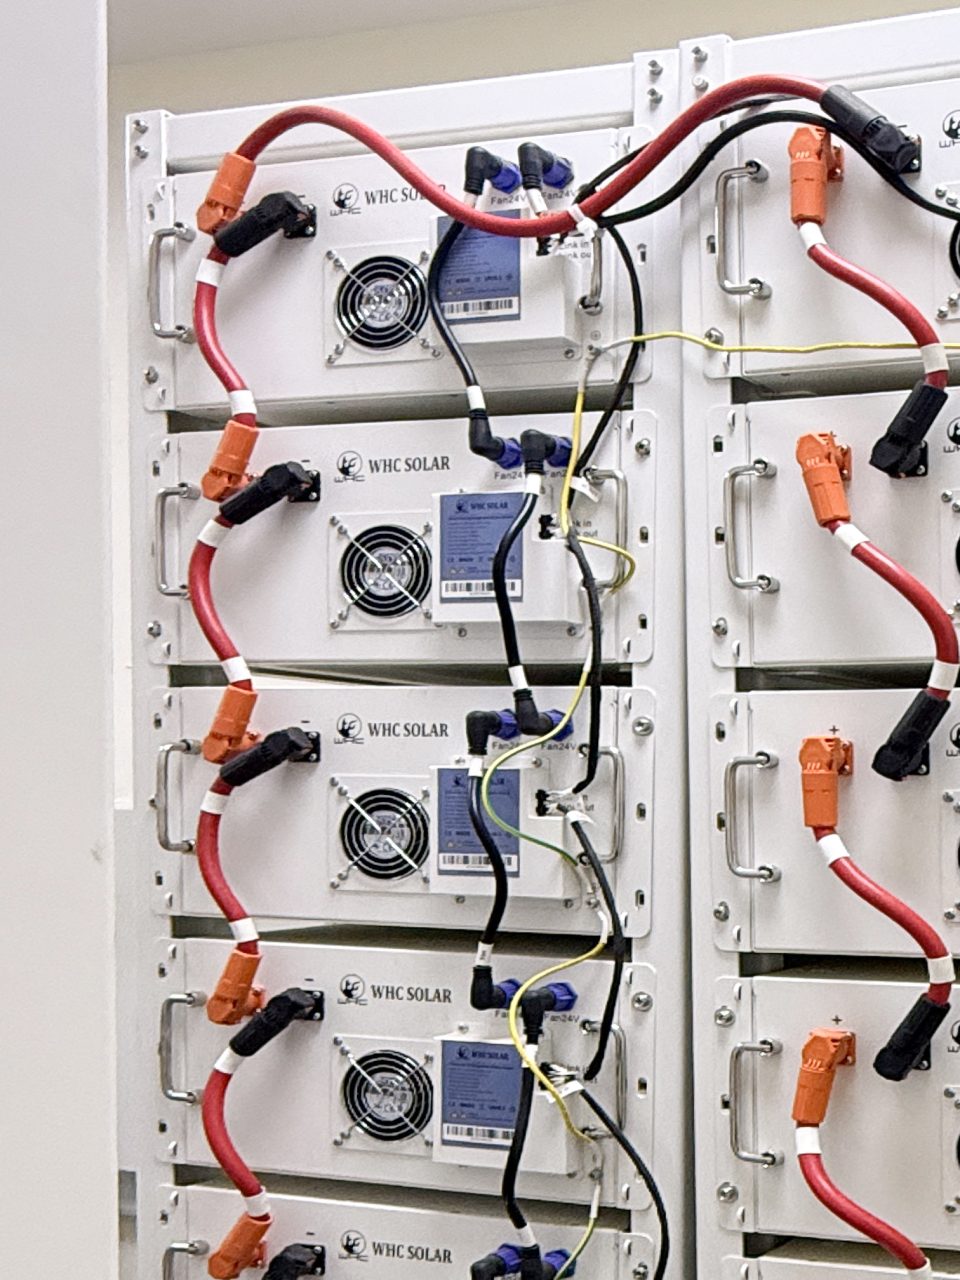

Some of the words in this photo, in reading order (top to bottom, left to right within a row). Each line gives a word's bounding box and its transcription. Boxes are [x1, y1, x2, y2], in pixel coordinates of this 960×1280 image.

[365, 189, 398, 204] WHC
[369, 458, 401, 473] WHC
[404, 456, 450, 471] SOLAR
[494, 469, 523, 480] Fan24
[368, 722, 400, 737] WHC
[403, 722, 449, 737] SOLAR
[371, 985, 404, 1000] WHC
[407, 987, 451, 1003] SOLAR
[372, 1242, 405, 1258] WHC
[407, 1245, 452, 1263] SOLAR
